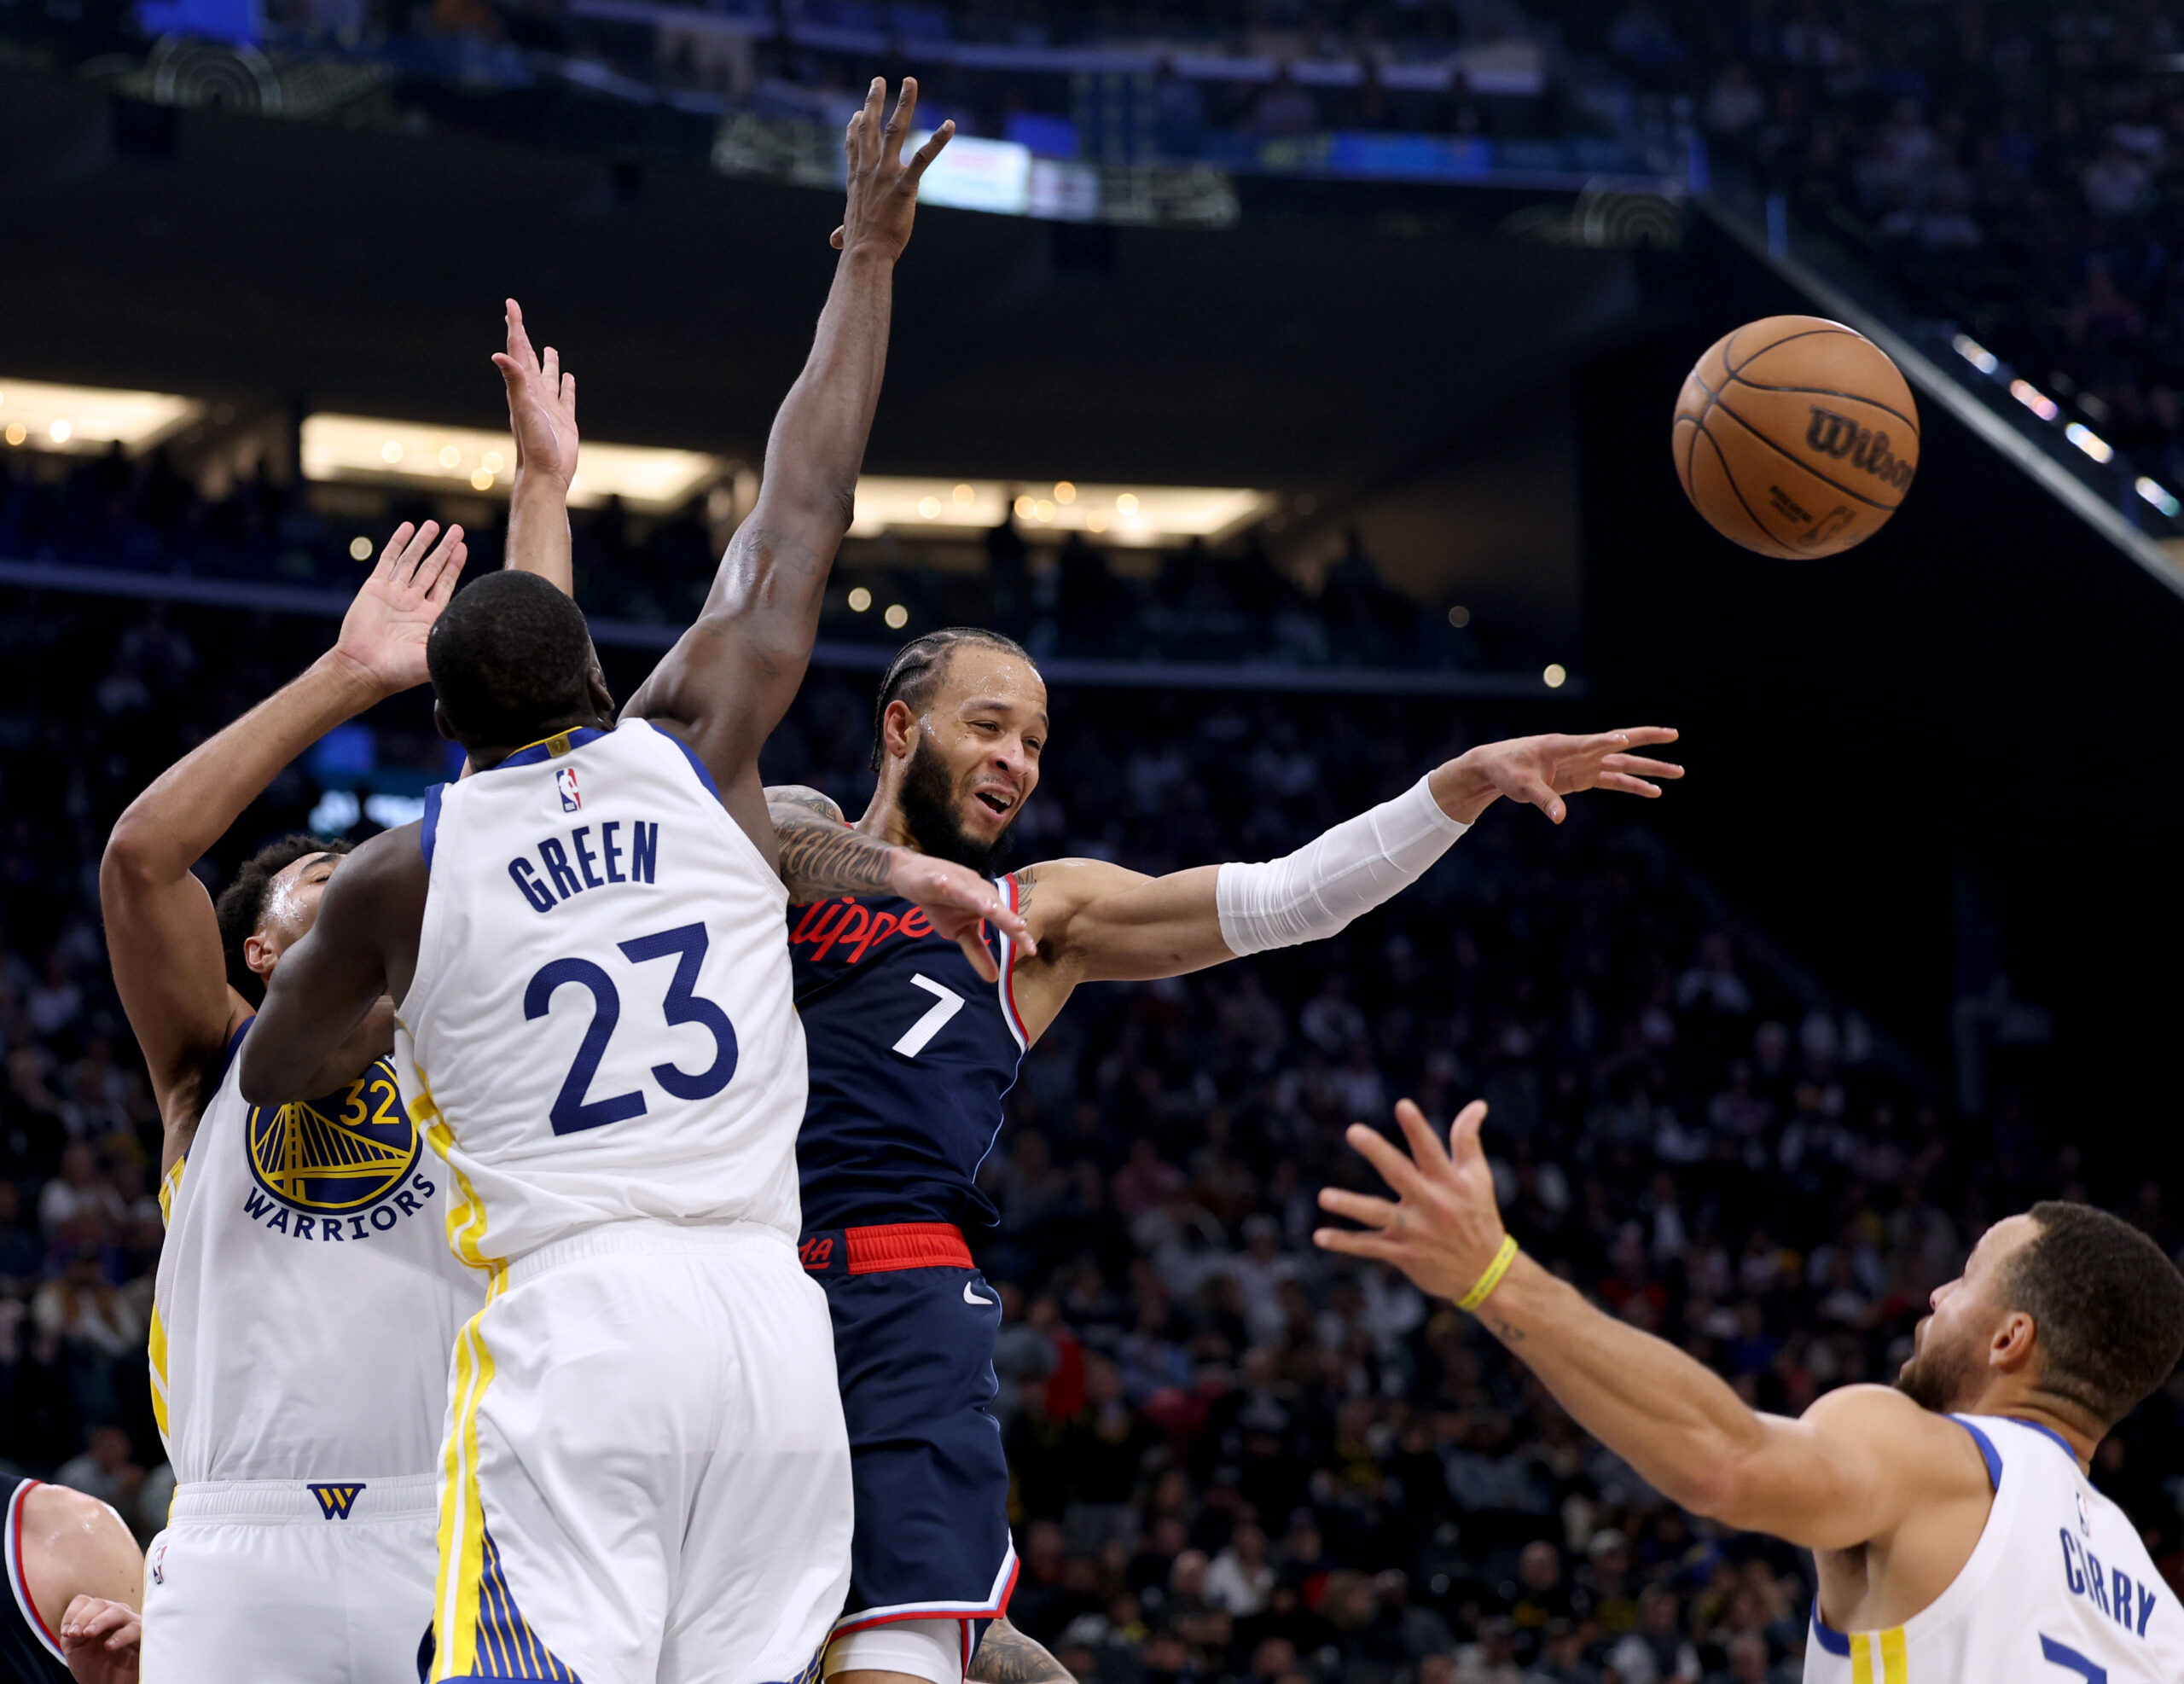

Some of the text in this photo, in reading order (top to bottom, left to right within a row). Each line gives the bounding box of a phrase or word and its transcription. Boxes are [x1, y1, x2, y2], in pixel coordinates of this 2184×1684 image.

[508, 821, 659, 913] GREEN
[524, 921, 739, 1136] 23
[892, 973, 966, 1058] 7
[339, 1079, 400, 1126] 32
[243, 1173, 436, 1242] WARRIORS
